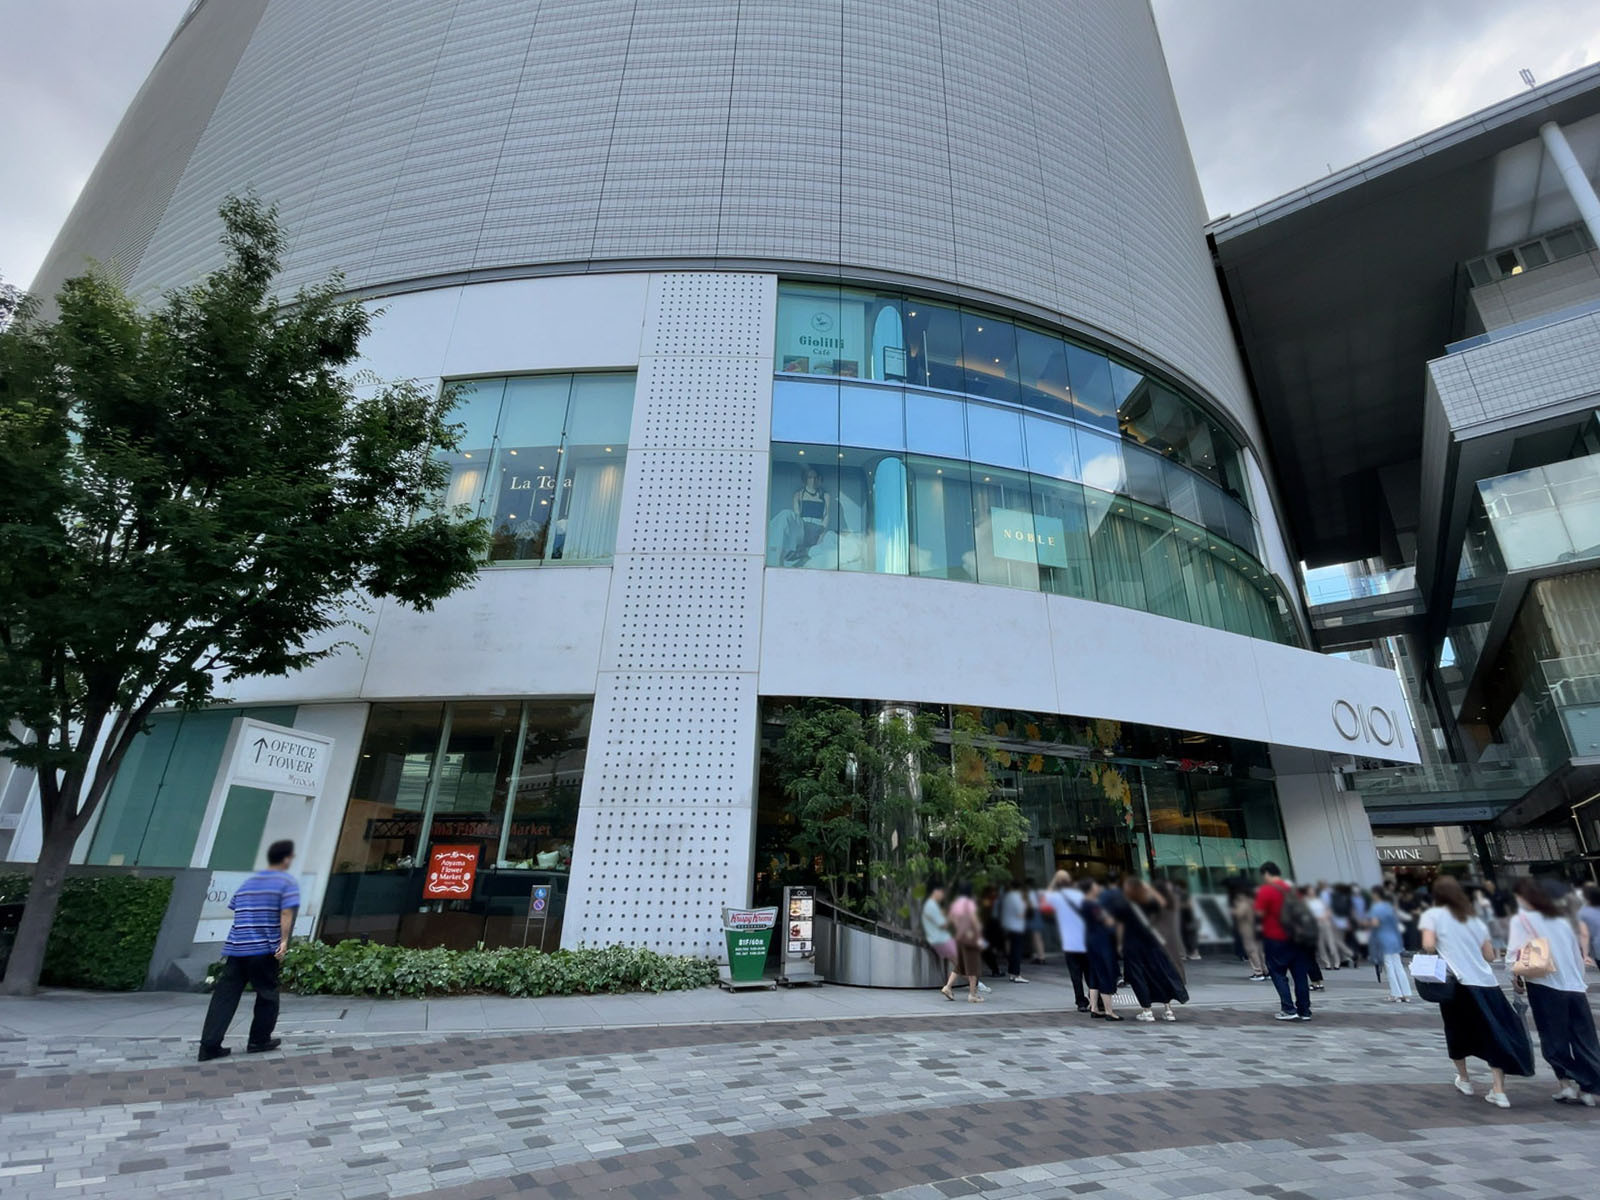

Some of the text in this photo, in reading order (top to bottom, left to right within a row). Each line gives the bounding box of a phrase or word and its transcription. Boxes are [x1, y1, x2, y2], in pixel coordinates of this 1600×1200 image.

[510, 475, 572, 490] La Toa
[1003, 528, 1055, 546] NOBLE
[270, 738, 317, 760] OFFICE
[268, 754, 313, 774] TOWER
[1376, 848, 1423, 860] UMINE
[440, 859, 466, 867] Aoyama
[439, 872, 462, 880] Market
[441, 866, 463, 874] Flower
[731, 911, 774, 924] Krispy Kreme
